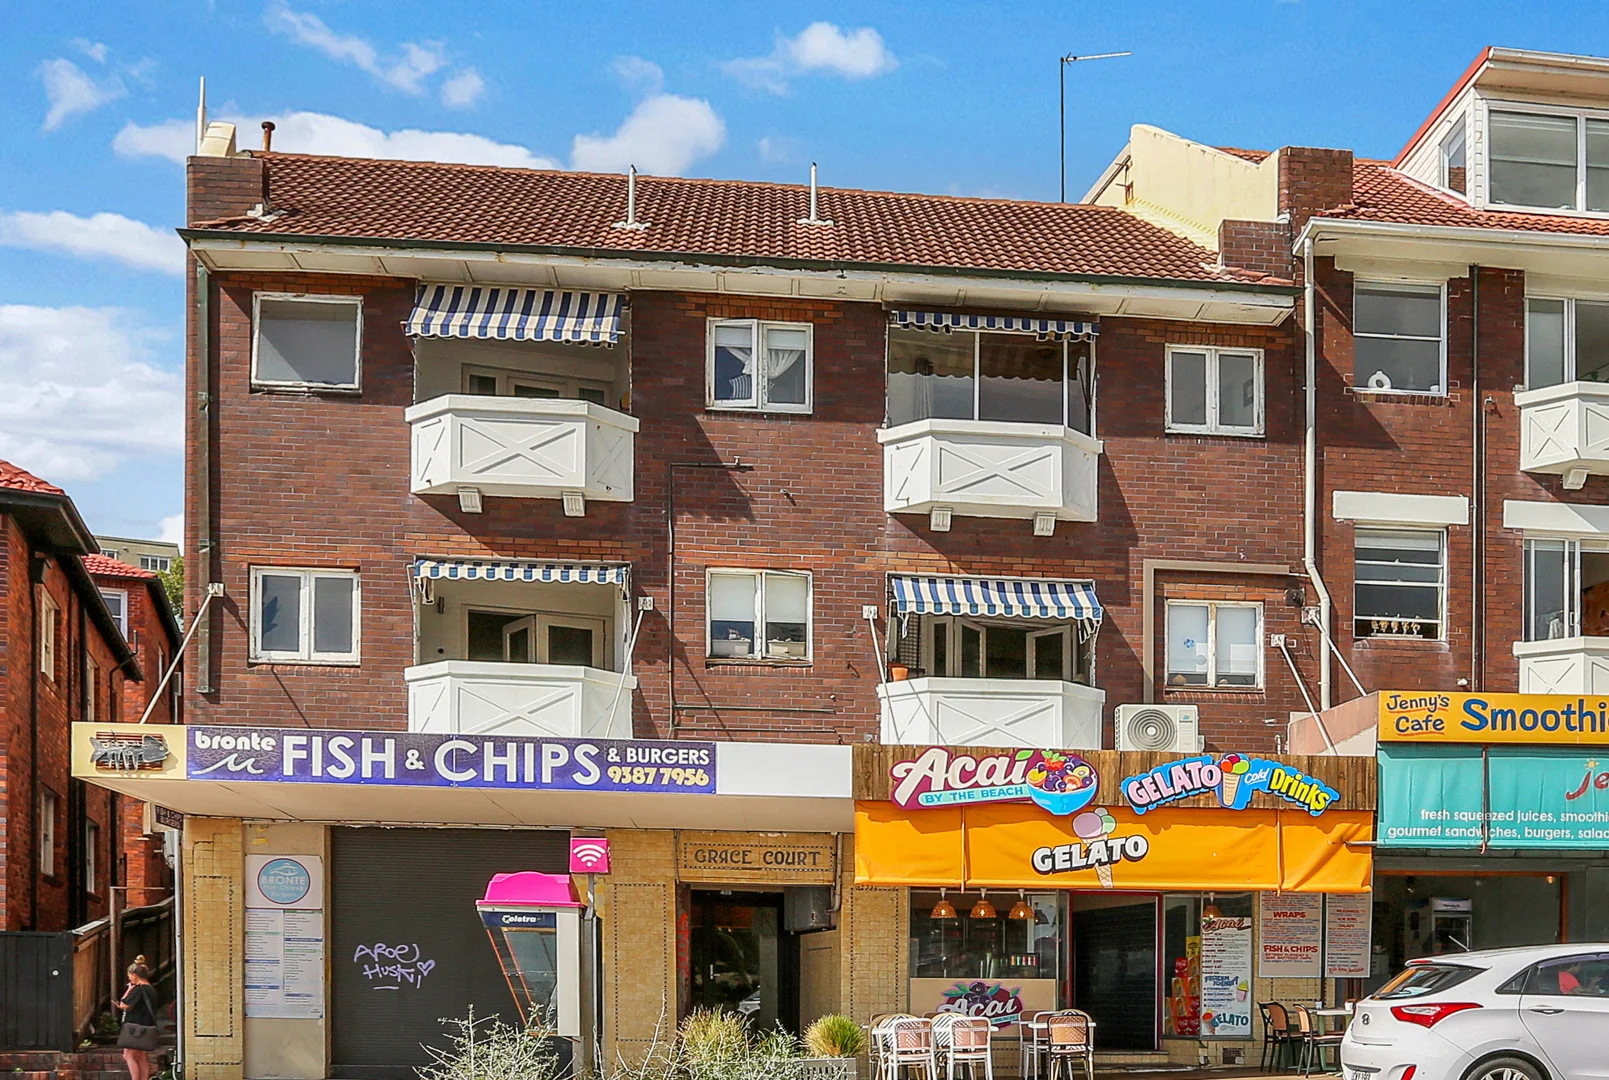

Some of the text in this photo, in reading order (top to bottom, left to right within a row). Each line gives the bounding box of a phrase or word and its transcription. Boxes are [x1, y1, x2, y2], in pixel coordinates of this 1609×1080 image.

[1386, 694, 1450, 713] Jenny's
[1395, 714, 1445, 733] Cafe
[1460, 698, 1609, 733] Smoothi
[195, 731, 277, 751] bronte
[283, 735, 600, 786] FISH & CHIPS
[607, 747, 710, 765] & BURGERS
[607, 765, 710, 786] 9387 7956
[892, 747, 1030, 807] Acai
[1128, 761, 1222, 805] GELATO
[925, 786, 1024, 803] BY THE BEACH
[1270, 768, 1330, 811] Drinks
[1420, 808, 1450, 820] fresh
[1517, 809, 1557, 824] juices,
[1560, 811, 1609, 823] smoothi
[1387, 825, 1442, 839] gourmet
[1524, 826, 1575, 840] burgers,
[694, 849, 821, 866] GRACE COURT
[1032, 835, 1149, 873] GELATO
[261, 875, 305, 885] BRONTE
[1263, 945, 1318, 953] FISH & CHIPS
[1211, 1012, 1250, 1028] GELATO
